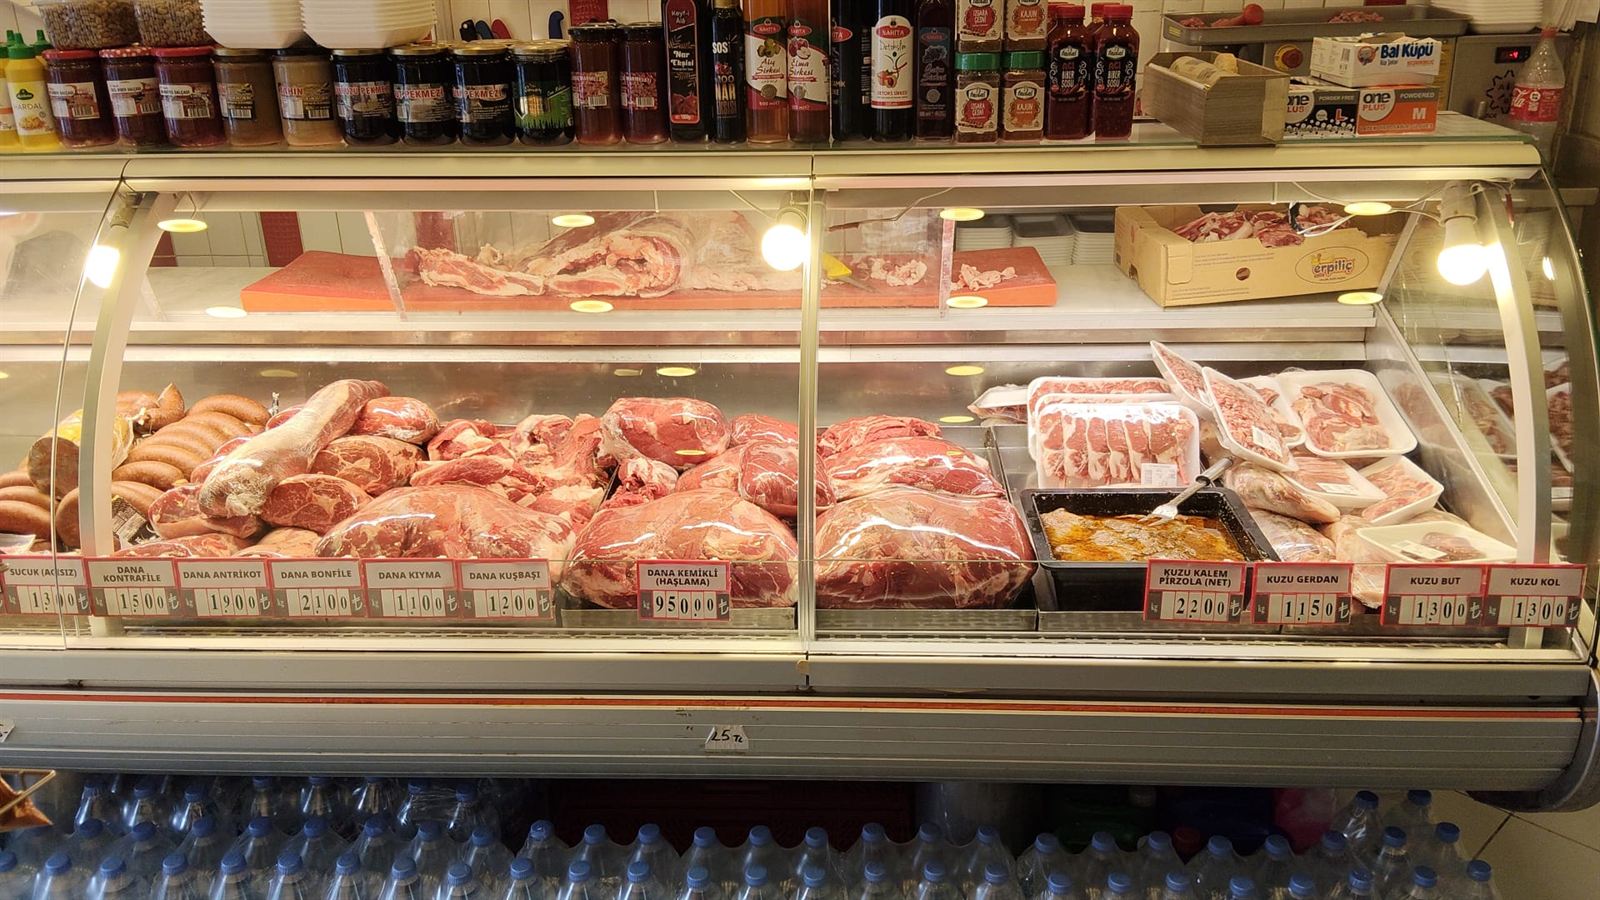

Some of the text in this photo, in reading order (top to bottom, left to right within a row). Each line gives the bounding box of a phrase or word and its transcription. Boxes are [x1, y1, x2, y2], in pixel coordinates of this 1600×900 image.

[712, 42, 728, 54] SOS
[1381, 42, 1433, 59] Bal Küpü
[673, 50, 690, 58] Nar
[1363, 92, 1391, 104] one
[1362, 104, 1386, 112] PLUS
[1334, 108, 1345, 122] L
[1412, 107, 1426, 120] M
[117, 566, 145, 574] DANA
[183, 568, 262, 579] DANA ANTRİKOT
[281, 568, 352, 579] DANA BONFİLE
[647, 567, 718, 578] DANA KEMİKLİ
[1163, 568, 1228, 578] KUZU KALEM
[103, 573, 161, 583] KONTRAFİLE
[378, 571, 441, 580] DANA KIYMA
[469, 571, 541, 581] DANA KUŞBAŞI
[1266, 575, 1339, 584] KUZU GERDAN
[655, 577, 710, 587] (HAŞLAMA)
[1159, 575, 1231, 588] PİRZOLA (NET)
[1410, 577, 1461, 585] KUZU BUT
[1510, 577, 1561, 586] KUZU KOL
